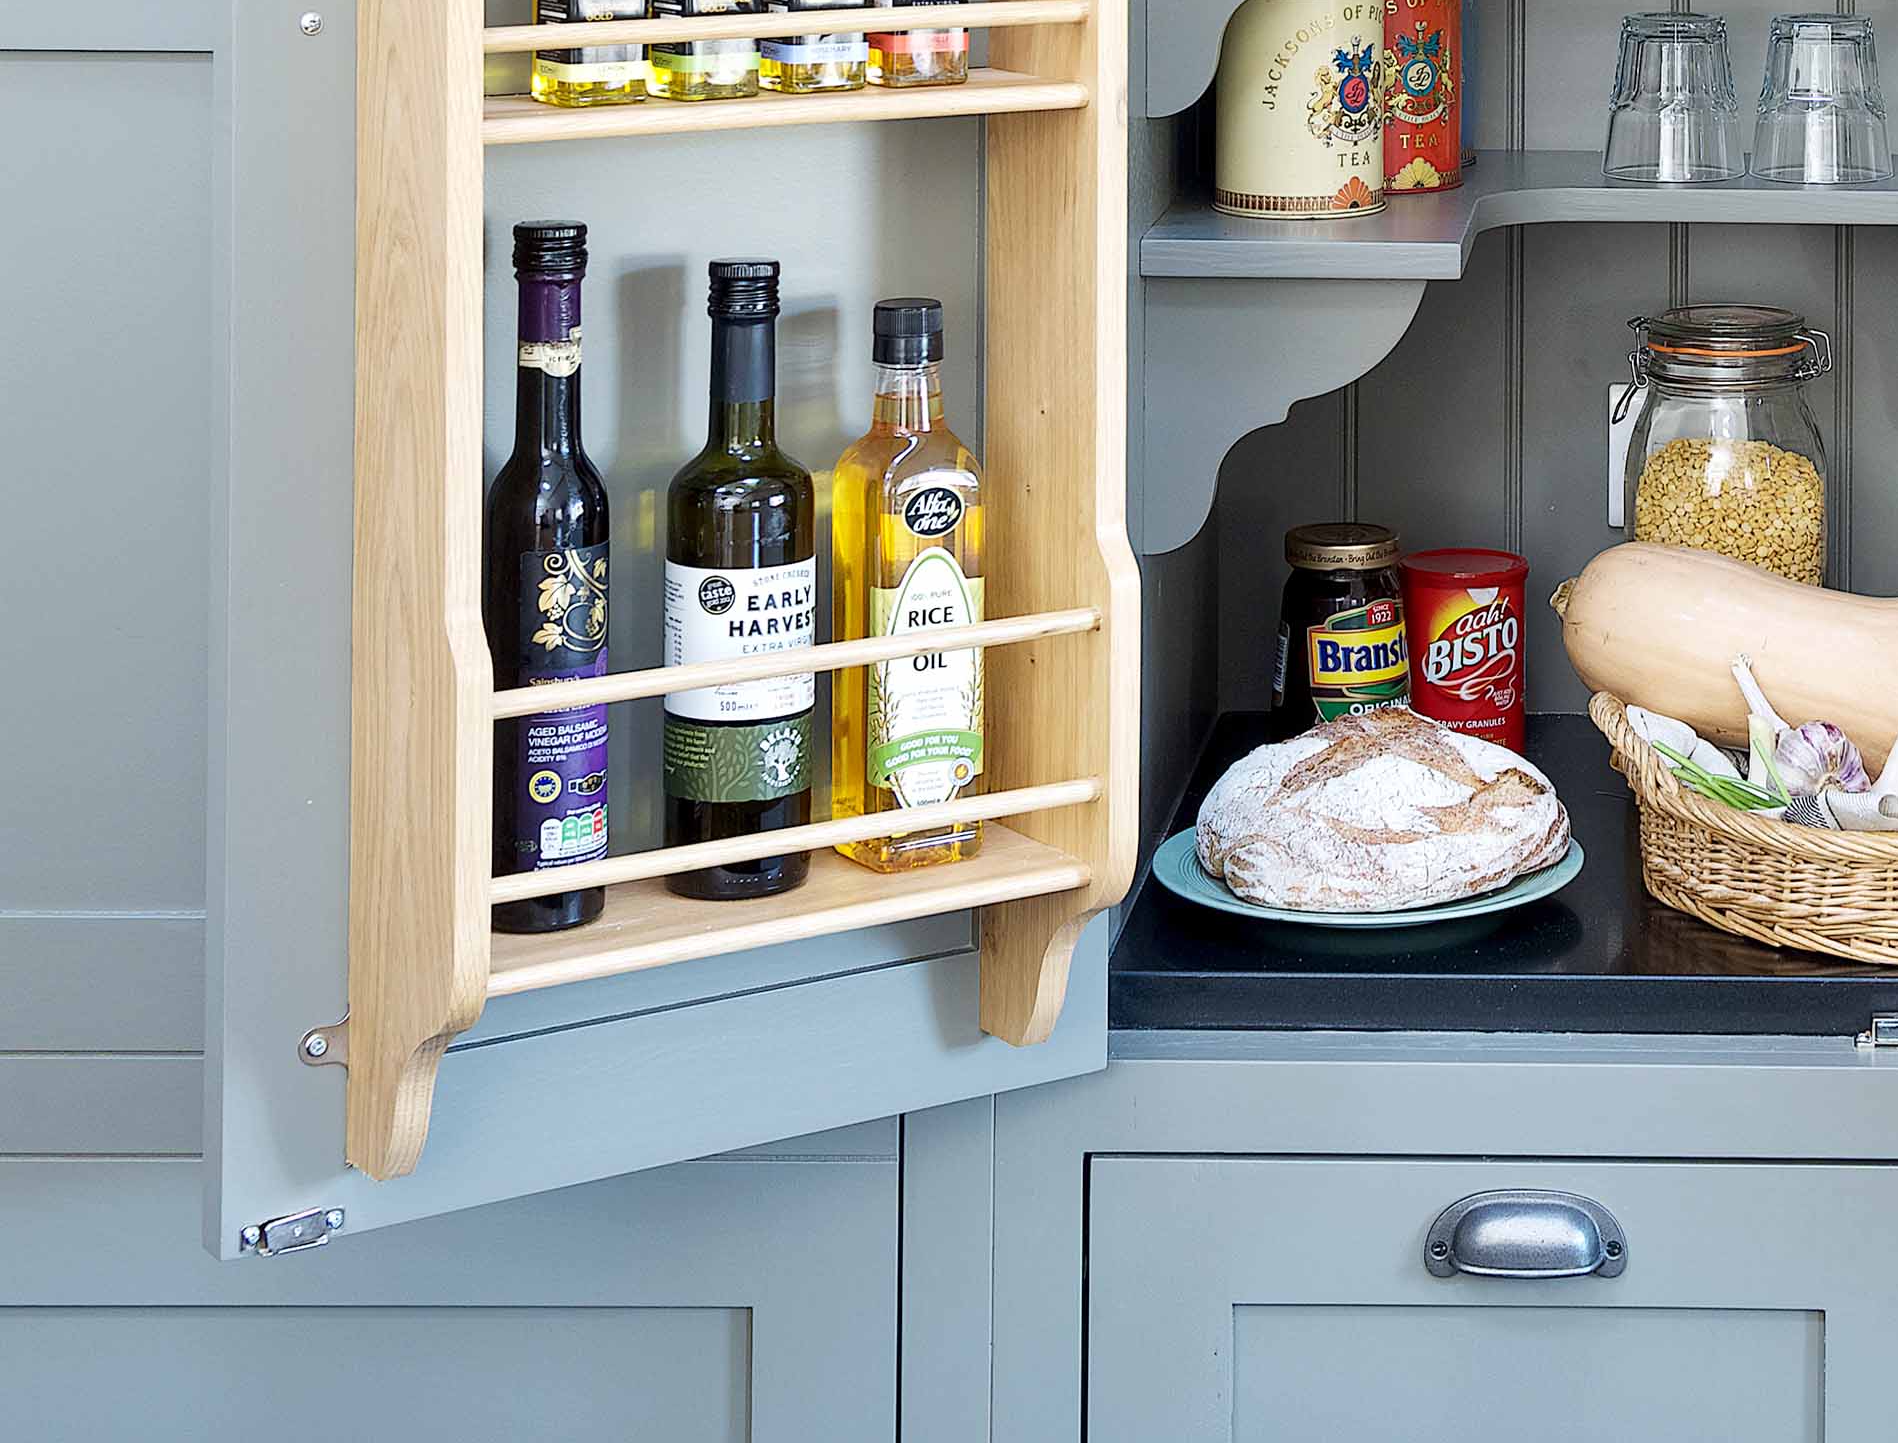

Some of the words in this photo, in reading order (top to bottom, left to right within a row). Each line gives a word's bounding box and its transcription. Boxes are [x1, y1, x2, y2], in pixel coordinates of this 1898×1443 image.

[586, 11, 613, 22] GOLD
[1262, 13, 1336, 111] JACKSONS
[1343, 4, 1364, 22] OF
[1400, 133, 1440, 149] TEA
[1337, 152, 1372, 168] TEA
[908, 491, 950, 517] Alfa
[913, 514, 949, 533] one
[700, 586, 733, 601] taste
[747, 583, 812, 612] EARLY
[1372, 603, 1390, 612] SINCE
[1456, 596, 1510, 636] aah!
[908, 606, 955, 629] RICE
[1371, 610, 1392, 625] 1922
[743, 641, 784, 654] EXTRA
[1317, 633, 1408, 673] Branst
[1427, 616, 1518, 683] BISTO
[913, 652, 948, 672] OIL
[528, 725, 556, 738] AGED
[557, 719, 599, 736] BALSAMIC
[1465, 716, 1506, 730] GRANULES
[528, 735, 571, 747] VINEGAR
[571, 731, 585, 744] OF
[901, 738, 923, 751] GOOD
[925, 736, 940, 747] FOR
[941, 734, 960, 746] YOU
[885, 754, 910, 769] GOOD
[911, 749, 926, 760] FOR
[927, 746, 950, 757] YOUR
